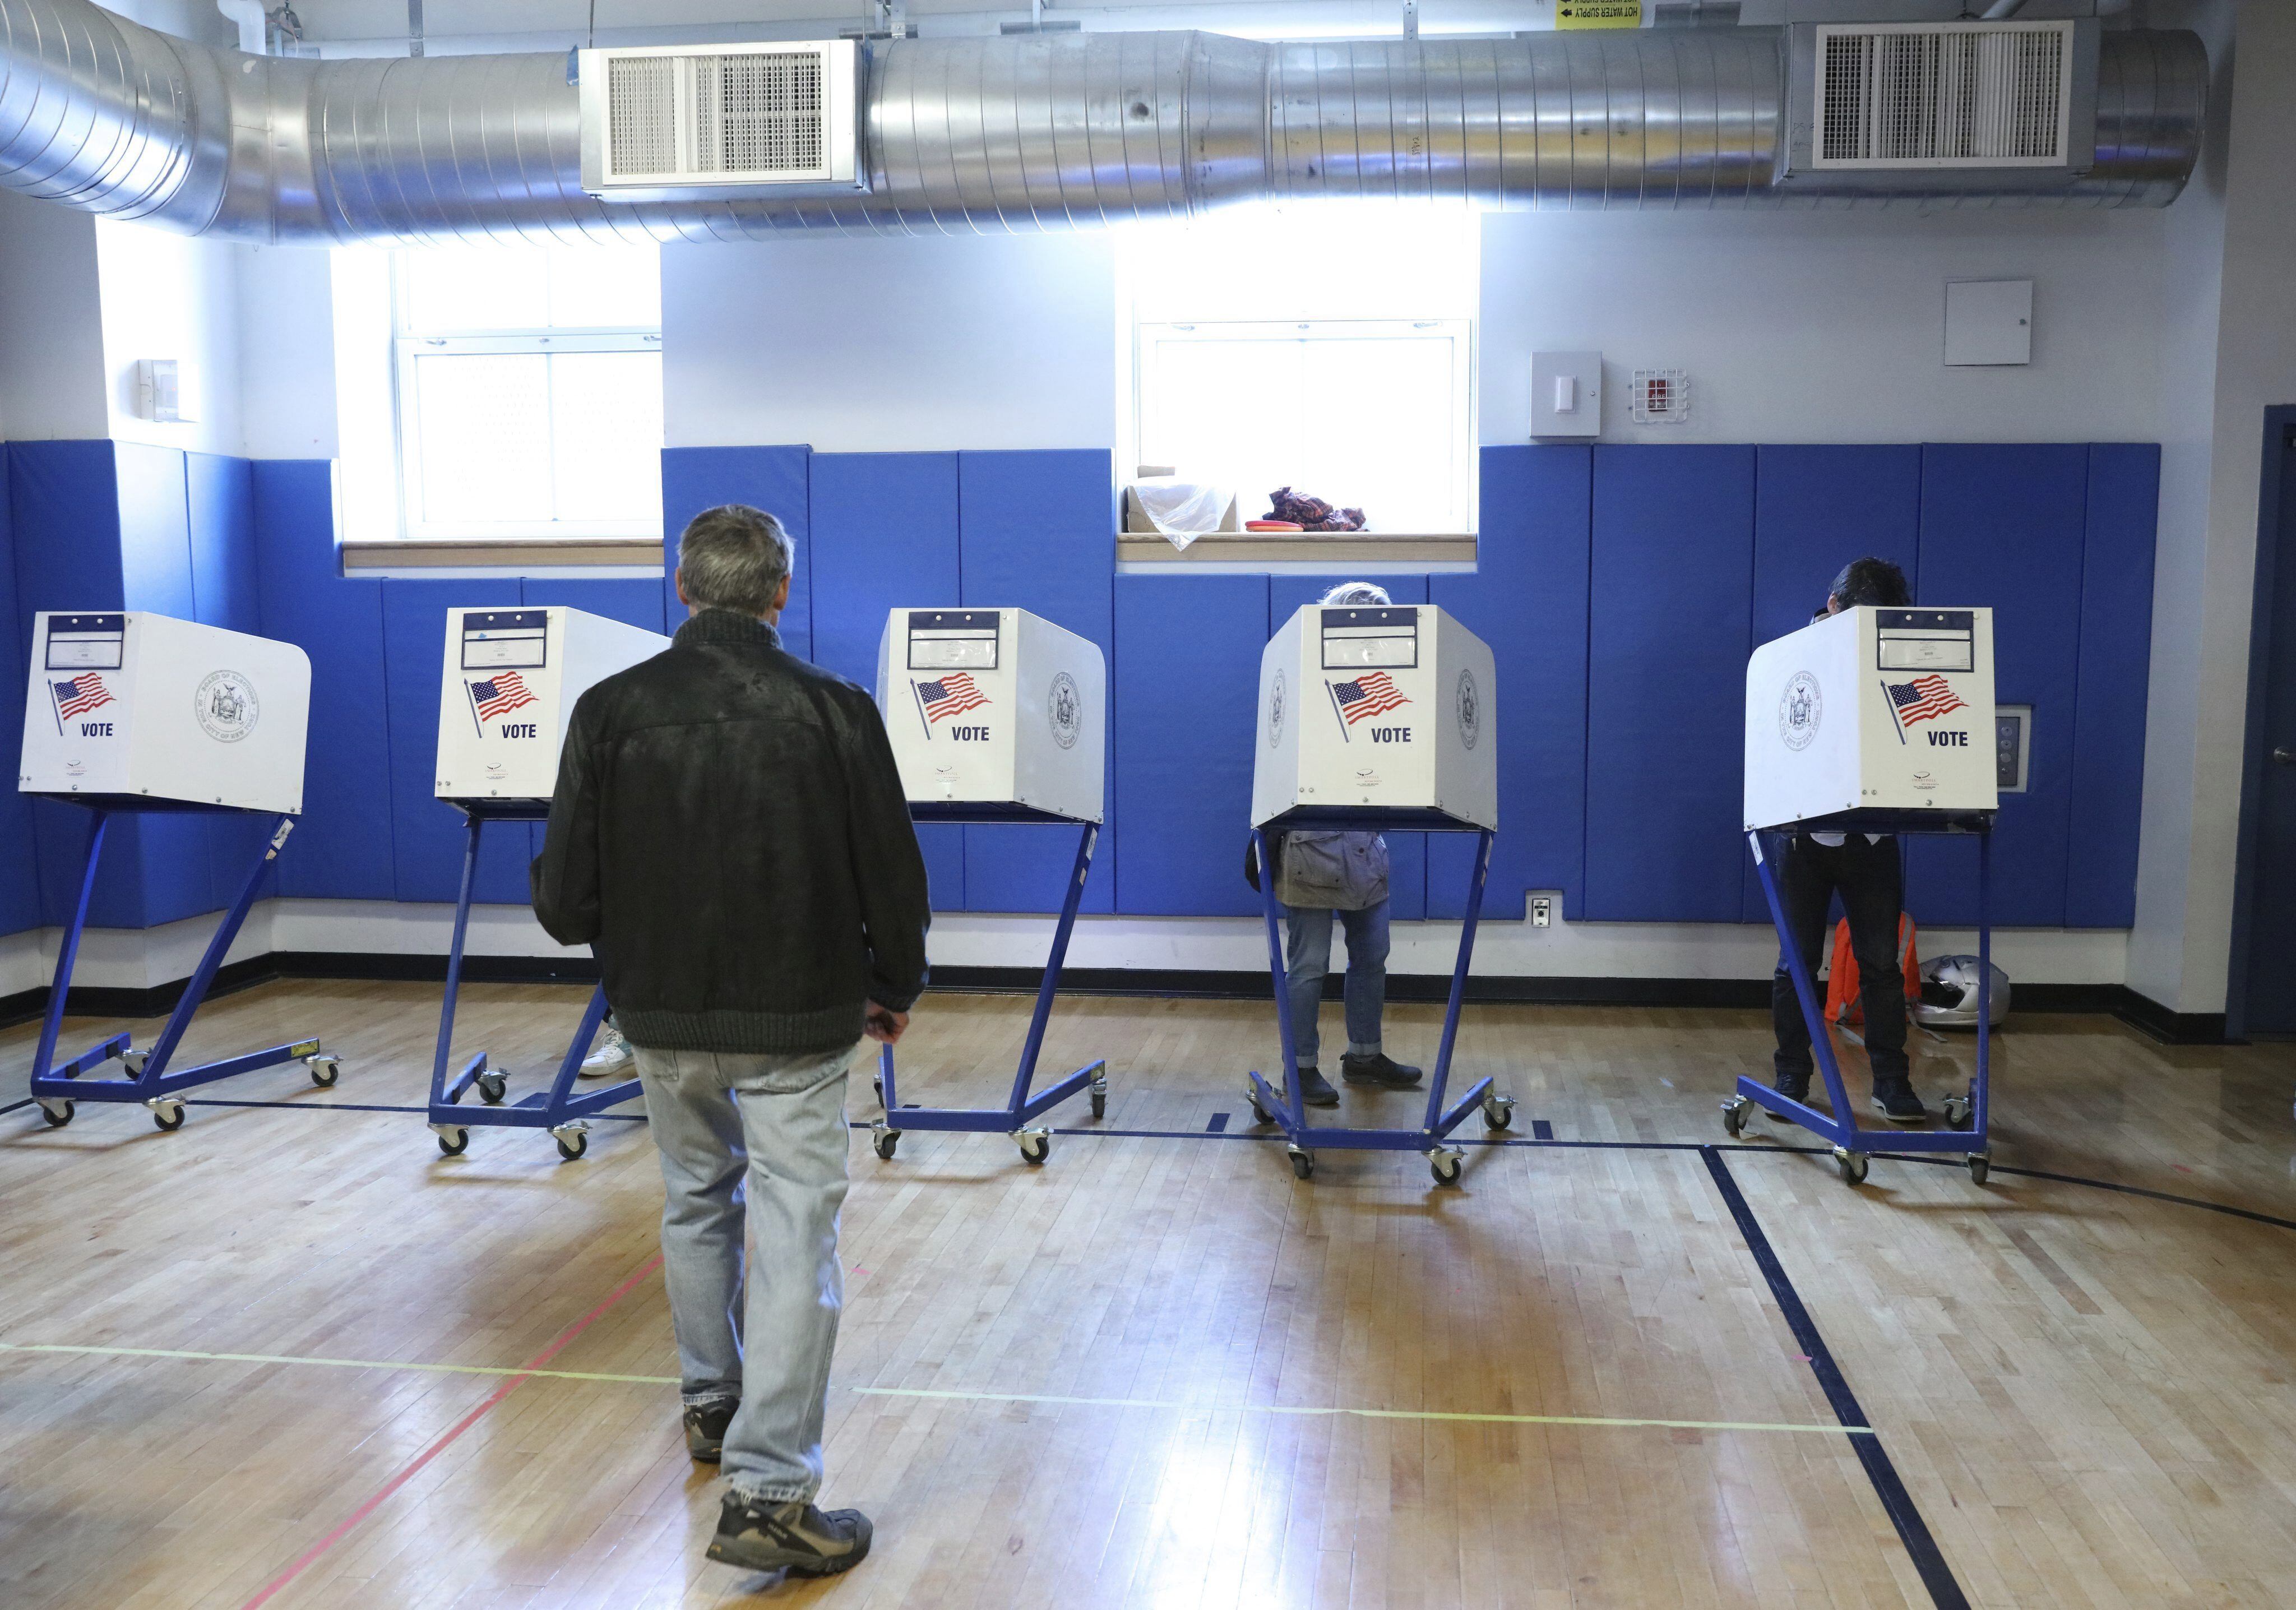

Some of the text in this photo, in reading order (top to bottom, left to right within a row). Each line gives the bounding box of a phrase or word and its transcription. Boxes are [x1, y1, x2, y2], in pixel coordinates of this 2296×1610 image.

[1575, 7, 1638, 17] HOT WATER SUPPLY
[202, 674, 220, 692] BOARD
[81, 723, 113, 737] VOTE
[230, 729, 244, 739] NEW
[502, 724, 536, 739] VOTE
[952, 727, 989, 741] VOTE
[1371, 728, 1411, 743] VOTE
[1927, 731, 1968, 747] VOTE
